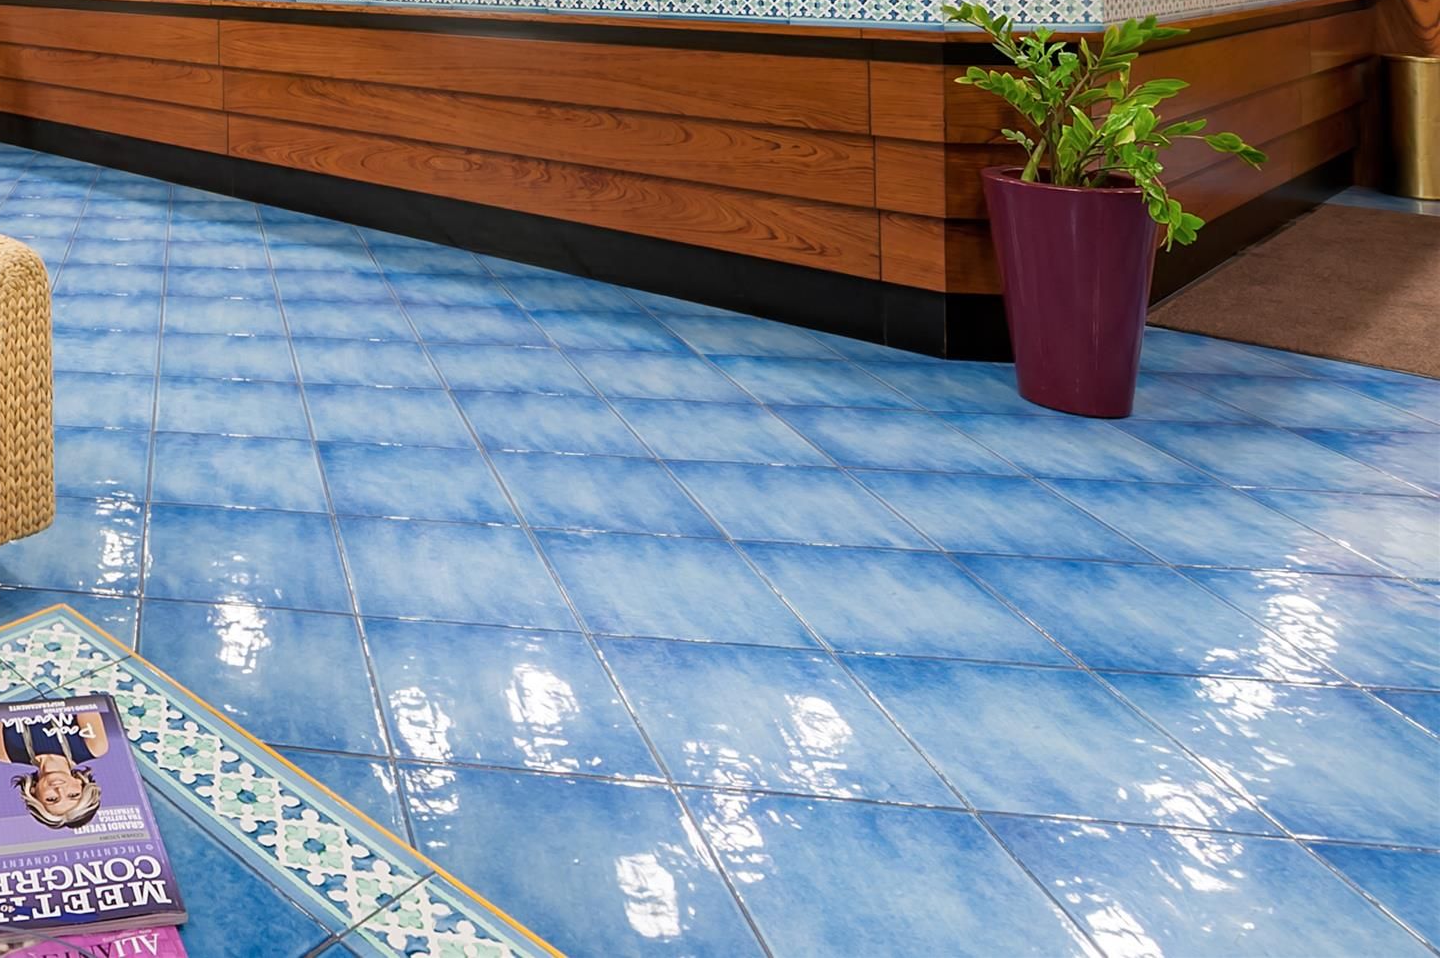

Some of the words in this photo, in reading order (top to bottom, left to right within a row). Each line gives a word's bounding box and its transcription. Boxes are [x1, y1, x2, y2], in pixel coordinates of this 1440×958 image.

[1, 712, 74, 734] Marella
[42, 722, 97, 744] Paola
[73, 823, 107, 835] EVENTI
[107, 821, 145, 832] GRANDI
[75, 845, 142, 860] INCENTIVE
